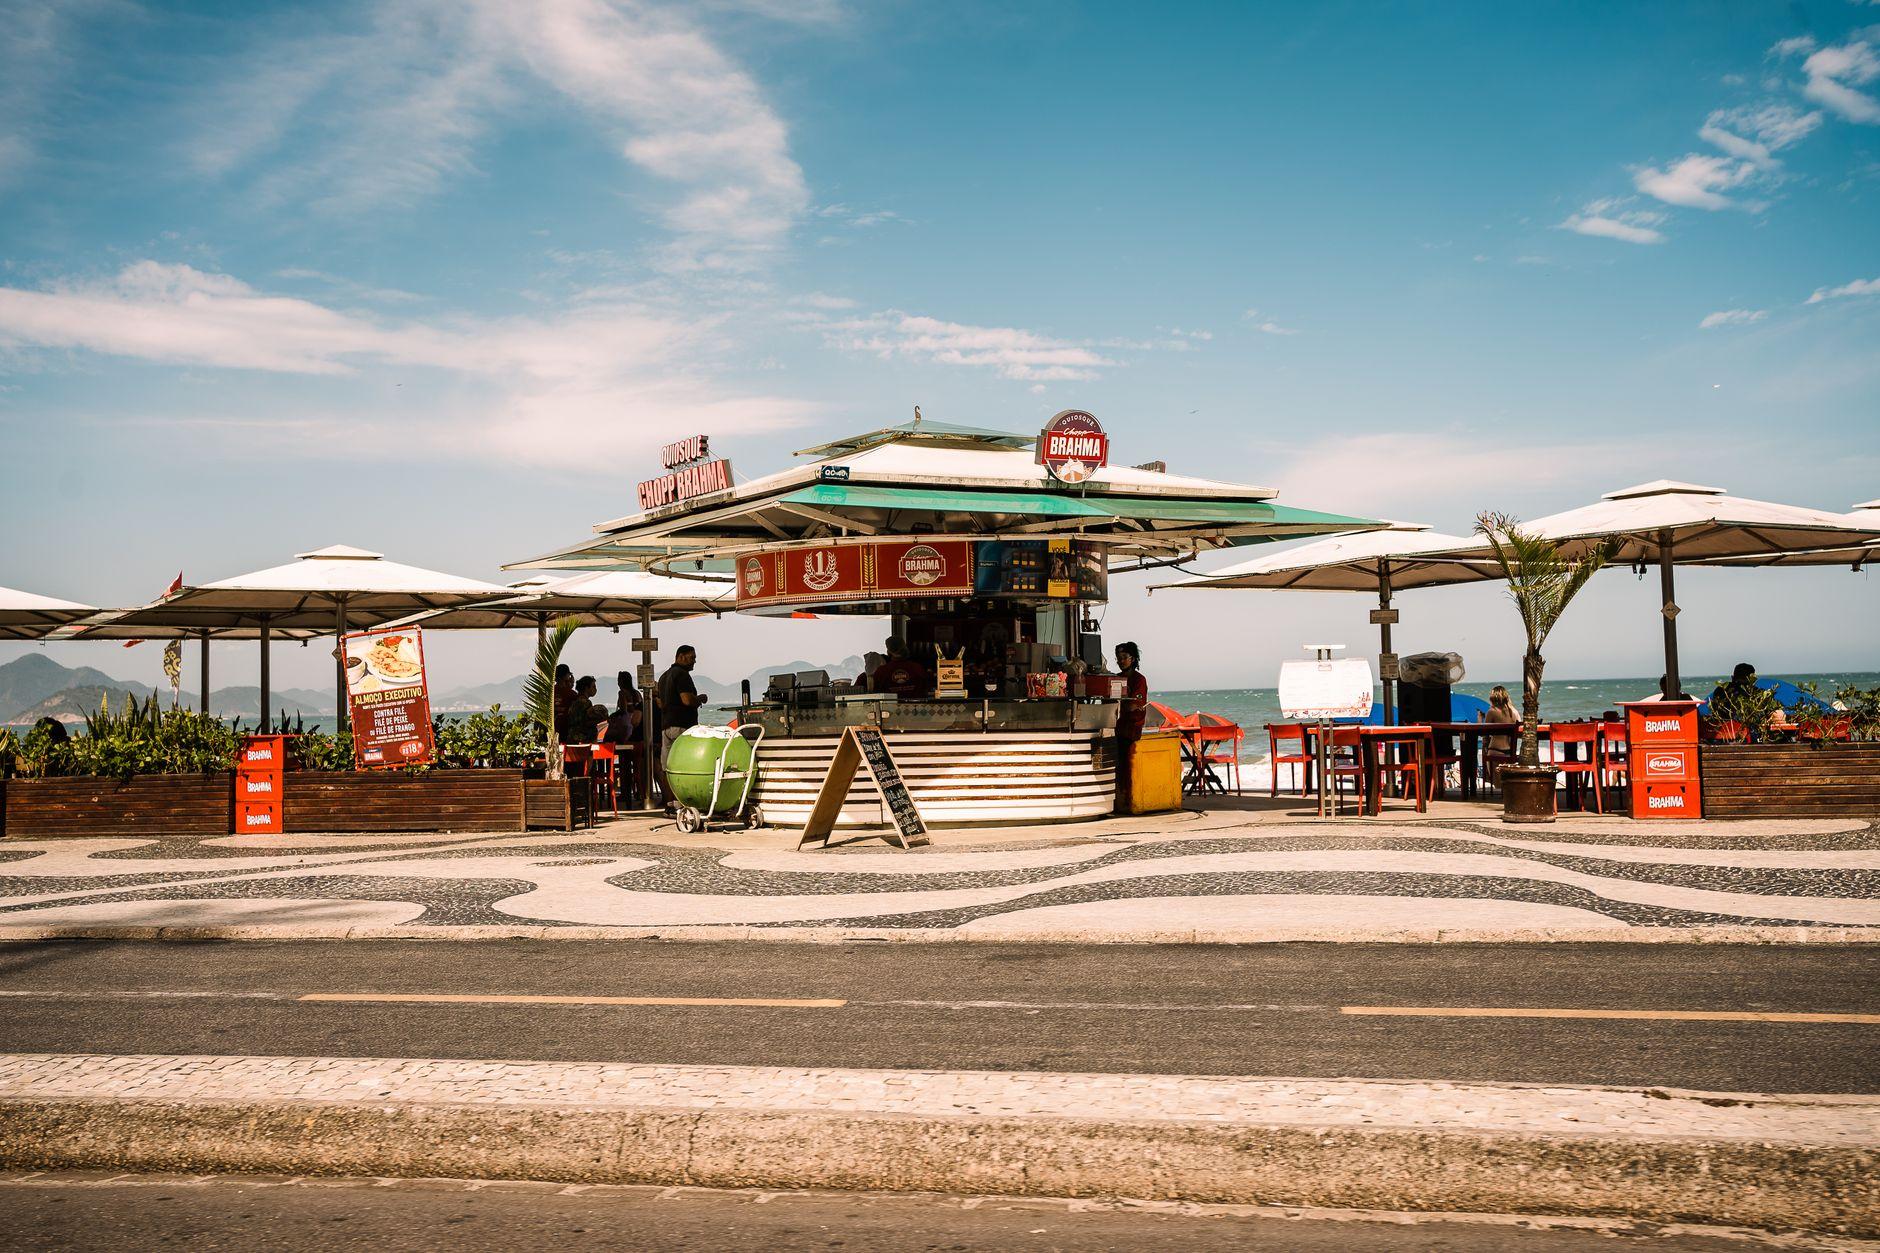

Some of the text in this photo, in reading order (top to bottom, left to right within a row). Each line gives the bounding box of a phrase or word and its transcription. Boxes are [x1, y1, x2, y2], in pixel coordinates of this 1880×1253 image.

[1062, 414, 1095, 427] QUIOSQUE
[661, 435, 703, 468] QUIOSQUE
[1049, 436, 1101, 457] BRAHMA
[637, 459, 728, 510] CHOPP BRAHMA
[815, 551, 825, 577] 1
[905, 560, 940, 571] BRAHMA
[355, 693, 382, 705] ALMOÇO
[385, 688, 421, 700] EXECUTIVO
[374, 709, 393, 718] CONTRA
[385, 717, 393, 725] DE
[394, 716, 408, 724] PEIXE
[1645, 720, 1681, 732] BRAHMA
[387, 725, 395, 733] DE
[395, 723, 415, 733] FRANGO
[247, 750, 272, 761] BRAHMA
[1649, 758, 1681, 768] BRAHMA
[247, 782, 272, 792] BRAHMA
[1648, 796, 1684, 808] BRAHMA
[246, 814, 272, 826] BRAHMA
